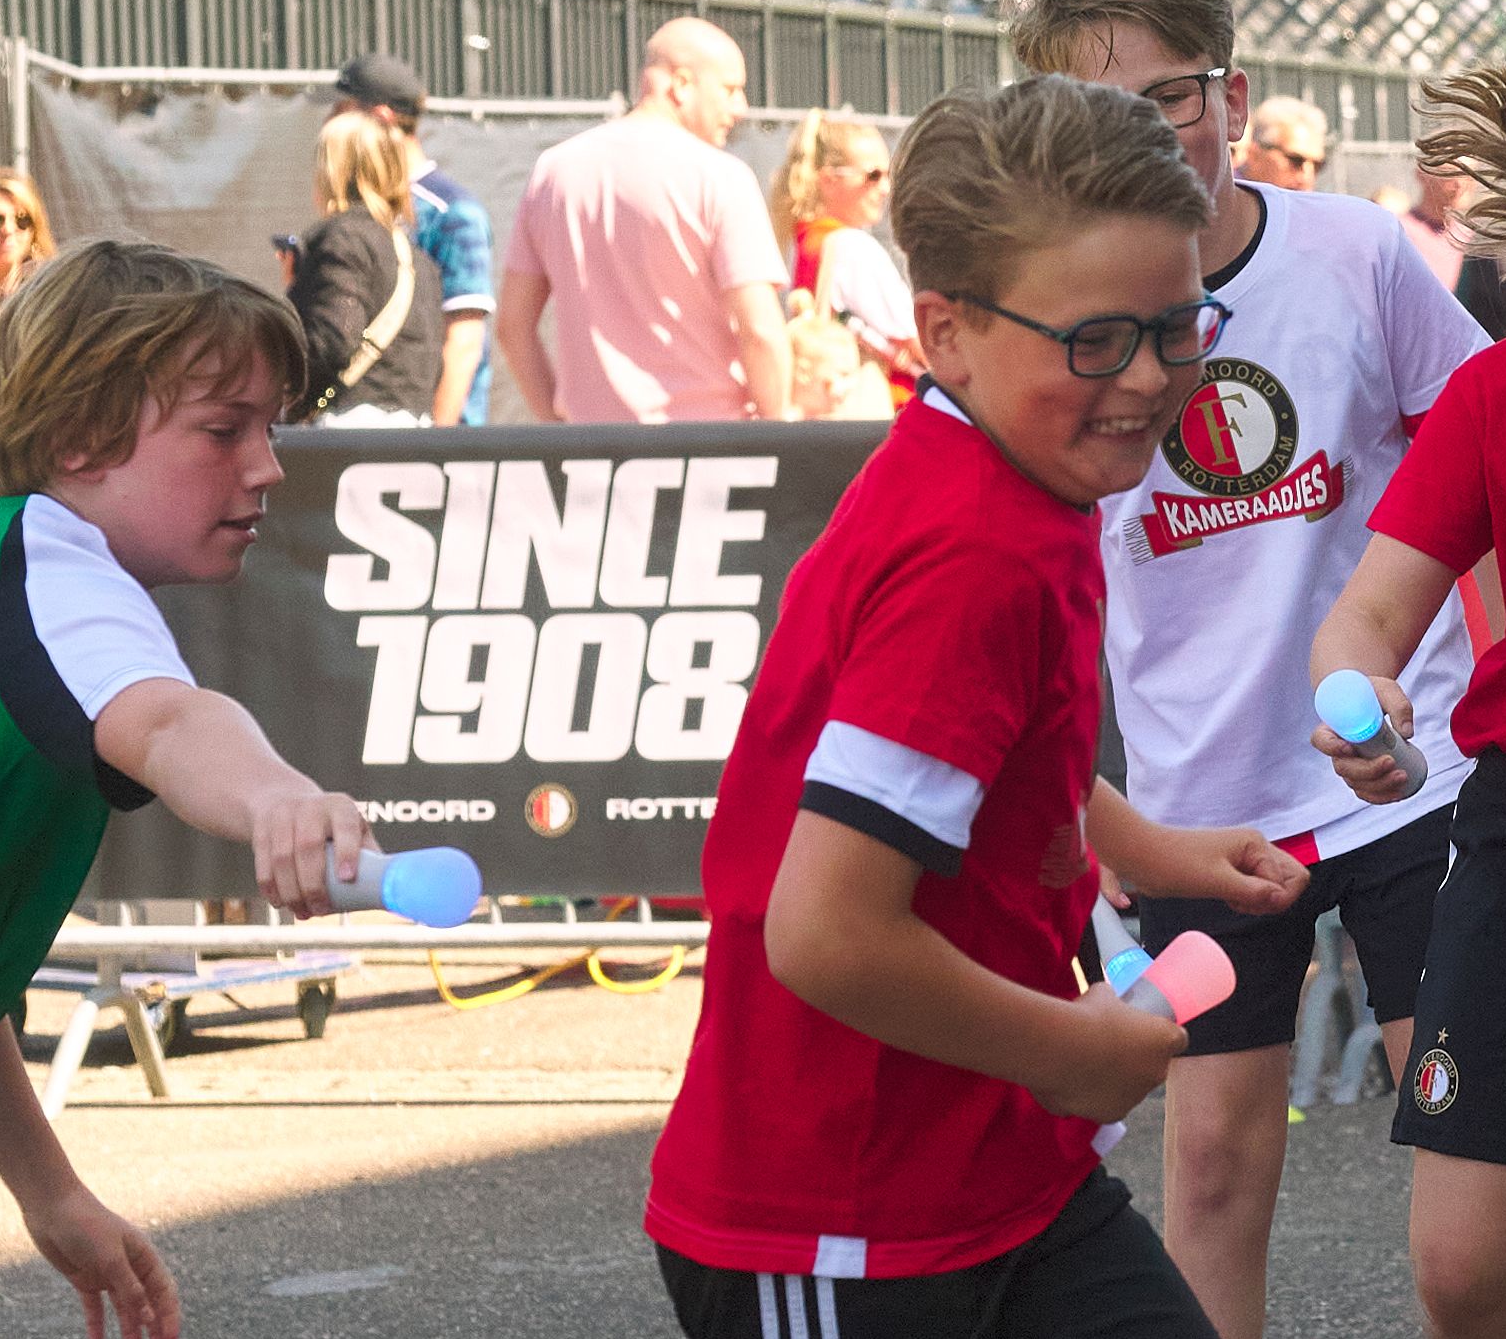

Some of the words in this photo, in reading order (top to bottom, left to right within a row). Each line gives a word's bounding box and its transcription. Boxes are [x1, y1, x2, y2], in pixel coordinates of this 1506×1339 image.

[1162, 463, 1329, 537] KAMERAADJES
[1179, 435, 1294, 494] ROTTERDAM
[325, 456, 779, 612] SINCE
[357, 612, 760, 765] 1908
